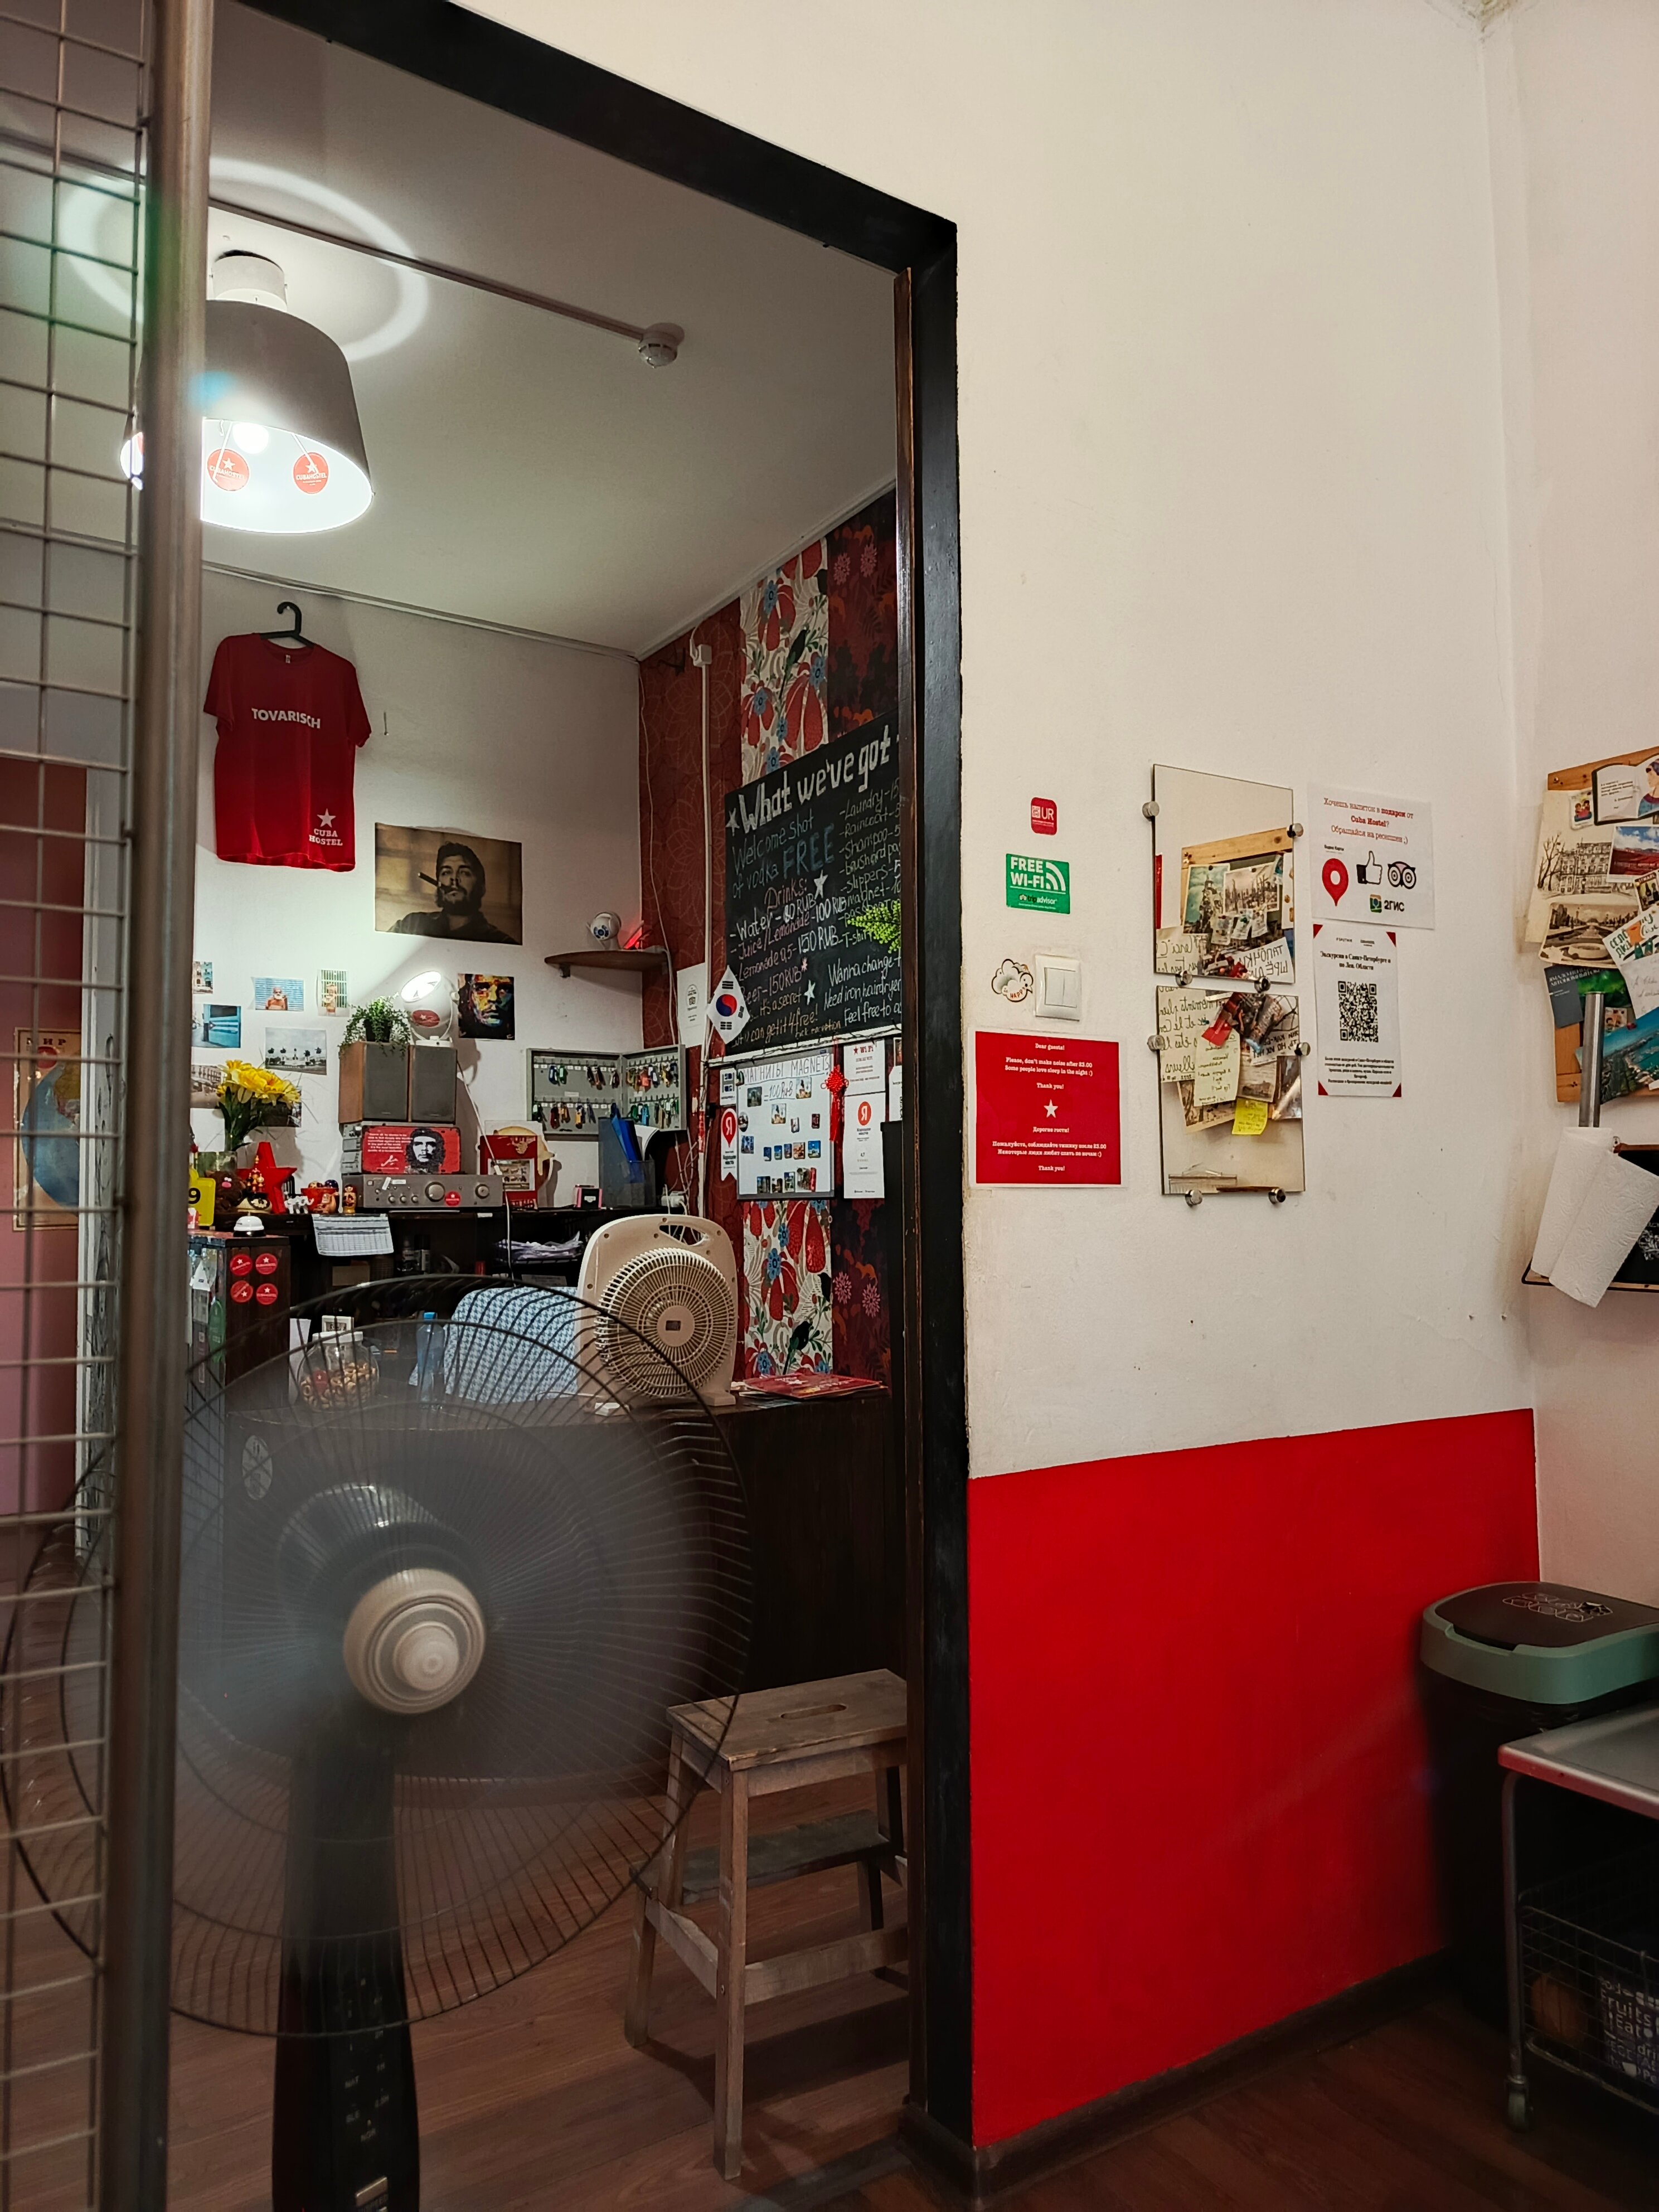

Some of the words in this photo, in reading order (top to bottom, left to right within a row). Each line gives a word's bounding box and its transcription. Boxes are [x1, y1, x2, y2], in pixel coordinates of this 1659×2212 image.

[251, 708, 321, 729] TOVARISCH
[739, 770, 792, 834] What
[797, 753, 854, 806] we've
[858, 725, 891, 793] got
[1324, 798, 1348, 808] Хочешь
[1351, 816, 1366, 824] Cuba
[309, 835, 343, 846] HOSTEL
[314, 828, 338, 837] CUBA
[732, 828, 787, 875] Welcome
[783, 823, 834, 879] FREE
[1010, 856, 1043, 873] FREE
[1010, 872, 1044, 888] WI-FI
[1027, 895, 1056, 904] tripadvisor
[1384, 900, 1404, 911] 2ГИС
[862, 955, 895, 979] change
[844, 1006, 861, 1027] Feel
[862, 1001, 880, 1023] free
[791, 1054, 830, 1076] MAGNETS
